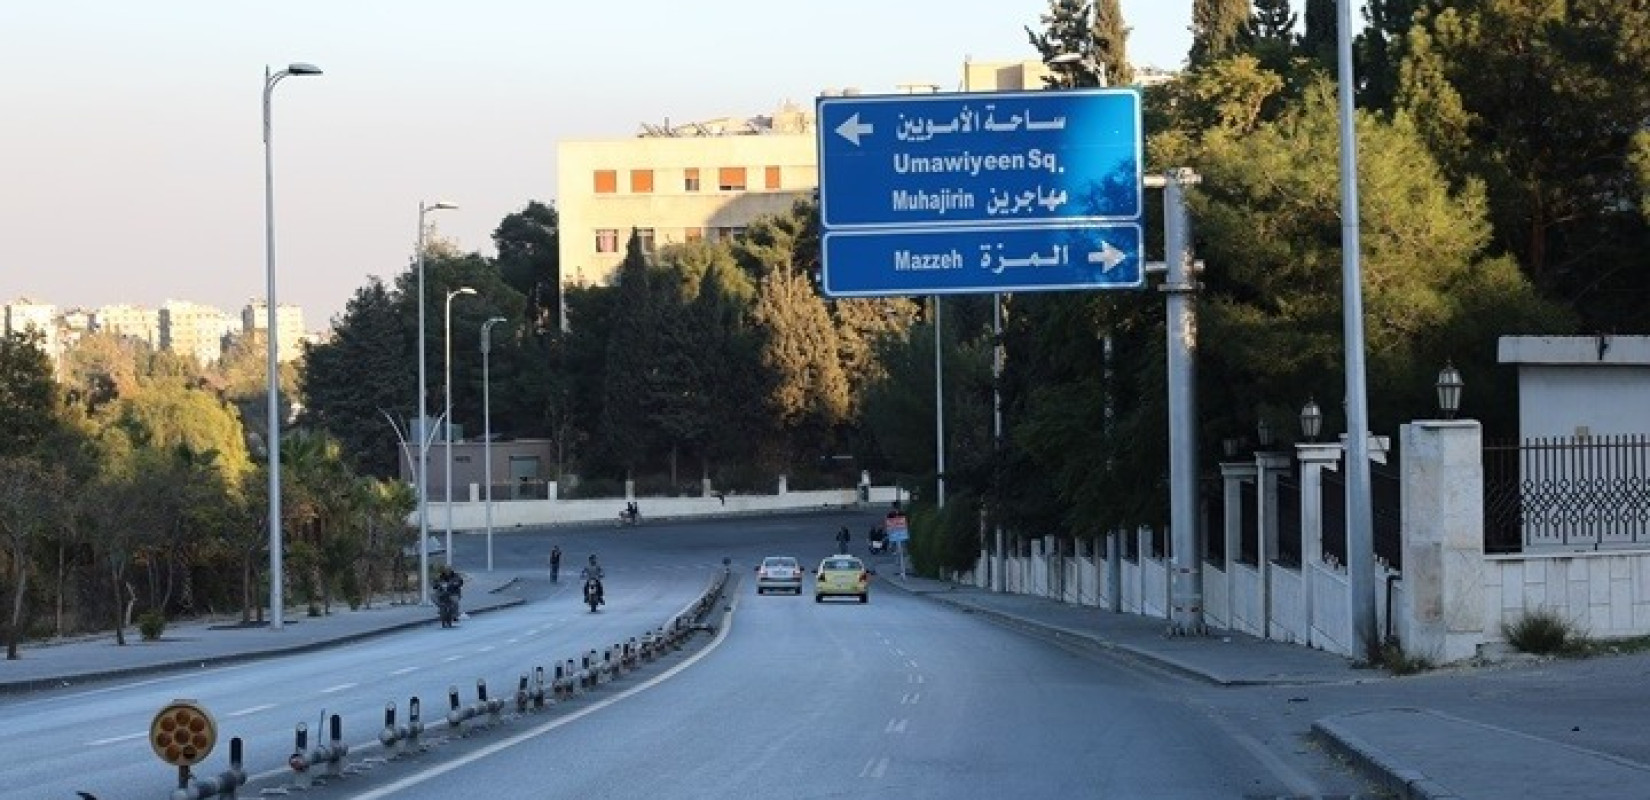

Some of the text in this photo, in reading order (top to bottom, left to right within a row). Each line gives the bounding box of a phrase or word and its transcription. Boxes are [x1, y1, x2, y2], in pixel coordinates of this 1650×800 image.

[897, 104, 1066, 140] ساحة الأمويين
[894, 148, 1065, 176] Umawiyeen Sq.
[893, 189, 975, 213] Muhajirin
[987, 186, 1067, 214] مهاجرين
[895, 250, 963, 271] Mazzeh
[980, 243, 1069, 273] المزة
